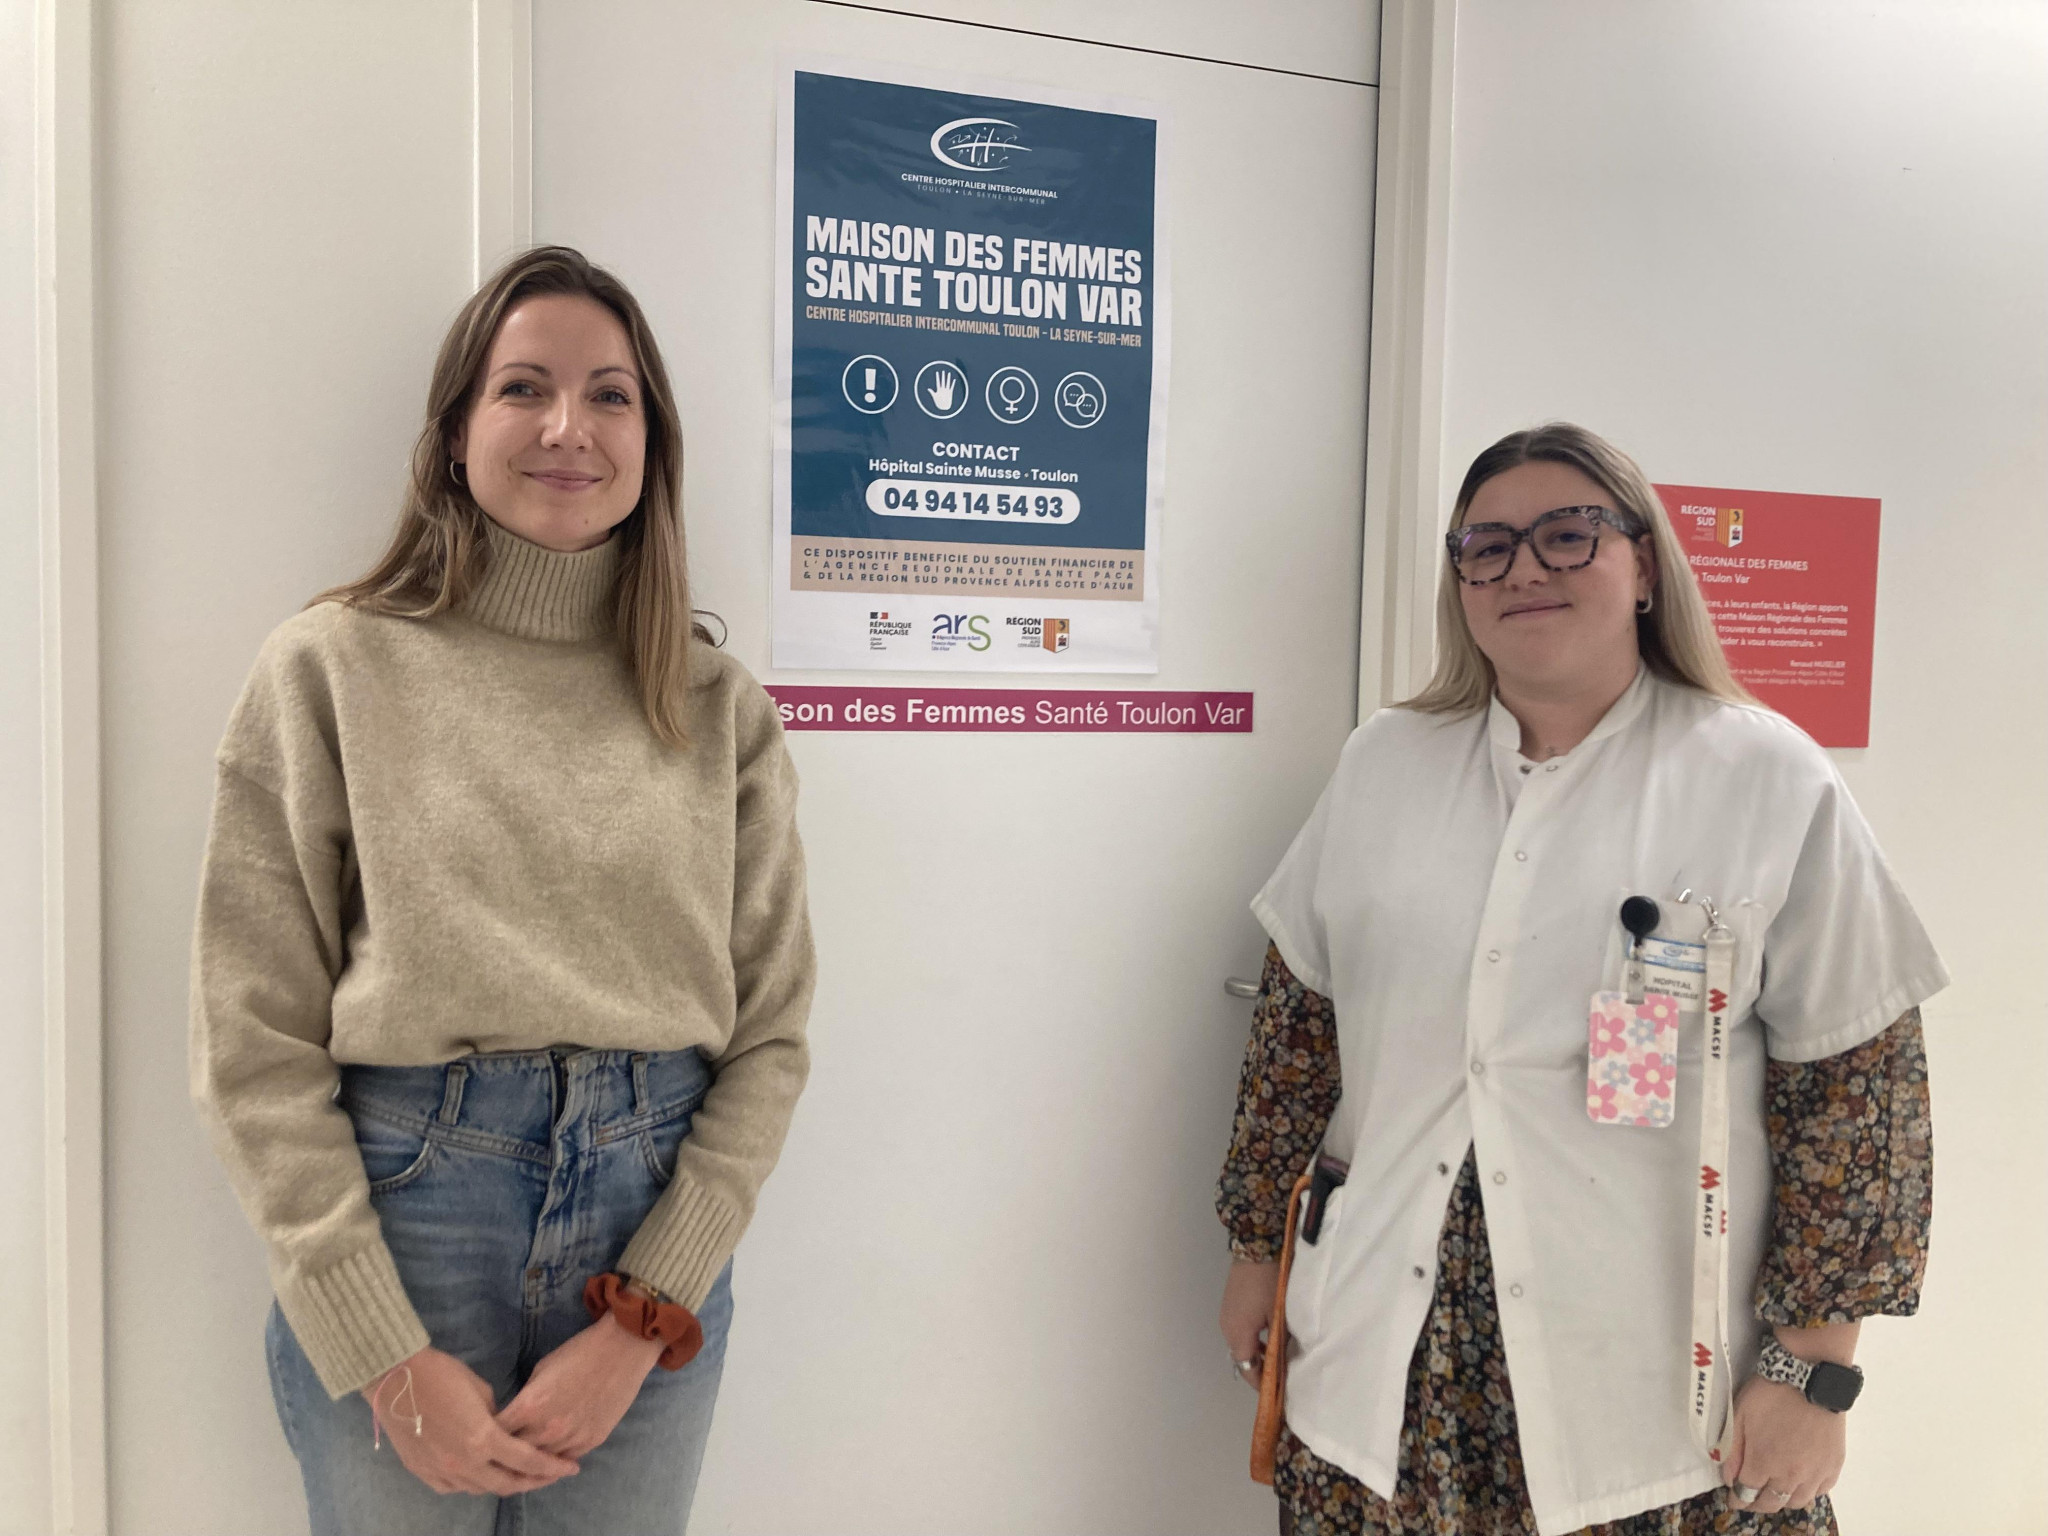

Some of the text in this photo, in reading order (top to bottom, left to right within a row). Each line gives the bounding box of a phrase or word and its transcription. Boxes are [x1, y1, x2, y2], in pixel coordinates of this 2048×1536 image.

[901, 173, 1058, 198] CENTRE HOSPITALIER INTERCOMMUNAL
[917, 184, 951, 194] TOULON
[976, 191, 1046, 205] SEYNE-SUR-MER
[806, 215, 1142, 285] MAISON DES FEMMES
[805, 256, 1143, 327] SANTE TOULON VAR
[806, 304, 846, 322] CENTRE
[849, 310, 912, 328] HOSPITALIER
[915, 315, 1000, 336] INTERCOMMUNAL
[1003, 323, 1040, 339] TOULON
[1050, 326, 1062, 340] LA
[1063, 328, 1142, 348] SEYNE-SUR-MER
[932, 441, 1020, 462] CONTACT
[869, 458, 923, 476] Hôpital
[926, 462, 972, 478] Sainte
[974, 466, 1020, 480] Musse
[1030, 468, 1078, 483] Toulon
[884, 487, 1063, 518] 04 94 14 54 93
[1696, 516, 1716, 526] SUD
[804, 548, 1134, 569] CE DISPOSITIF BENEFICIE DU SOUTIEN FINANCIER DE
[1690, 554, 1808, 571] RÉGIONALE DES FEMMES
[803, 572, 811, 580] &
[818, 572, 833, 580] DE
[860, 574, 908, 583] REGION
[915, 576, 938, 584] SUD
[944, 576, 1008, 586] PROVENCE
[1014, 579, 1049, 588] ALPES
[1055, 580, 1085, 588] COTE
[1091, 582, 1133, 590] D'AZUR
[902, 564, 994, 574] REGIONALE
[1006, 568, 1023, 576] DE
[1034, 569, 1082, 578] SANTE
[1094, 571, 1133, 580] PACA
[1702, 572, 1732, 583] Toulon
[1734, 574, 1751, 584] Var
[870, 620, 912, 630] RÉPUBLIQUE
[870, 628, 909, 636] FRANÇAISE
[1022, 626, 1042, 634] SUD
[844, 698, 896, 723] des
[906, 699, 1026, 725] Femmes
[1034, 700, 1108, 725] Santé
[1116, 700, 1196, 725] Toulon
[1204, 702, 1245, 726] Var
[1711, 1016, 1722, 1060] MACSF
[1704, 1192, 1714, 1238] MACSF
[1696, 1370, 1706, 1417] MACSF
